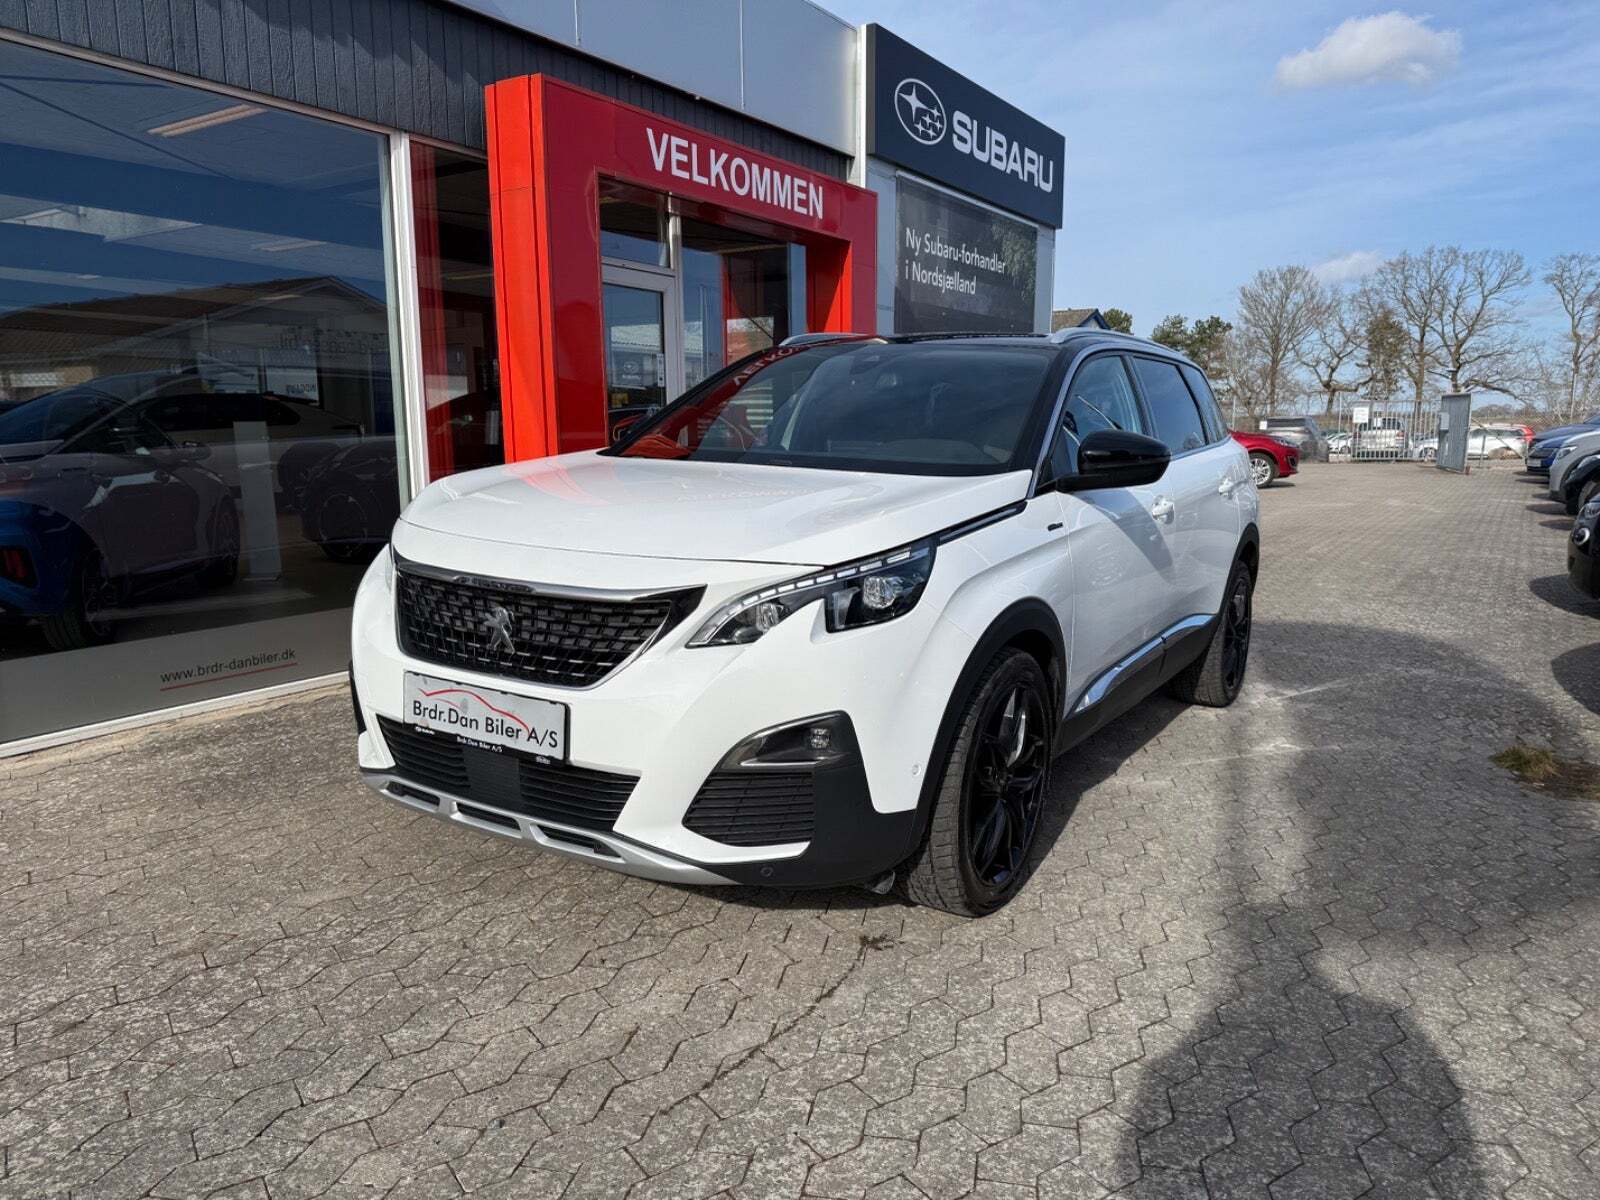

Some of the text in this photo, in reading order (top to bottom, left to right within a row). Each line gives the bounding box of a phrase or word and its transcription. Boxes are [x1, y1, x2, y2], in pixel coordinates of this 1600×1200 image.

[646, 127, 824, 220] VELKOMMEN
[952, 110, 1054, 193] SUBARU
[905, 227, 1006, 274] Ny Subaru-forhandler
[905, 259, 977, 295] i Nordsjælland
[160, 648, 296, 683] www.brdr-danbiler.dk
[412, 700, 479, 731] Brdr.Dan
[485, 717, 522, 739] Biler
[527, 727, 558, 748] A/S
